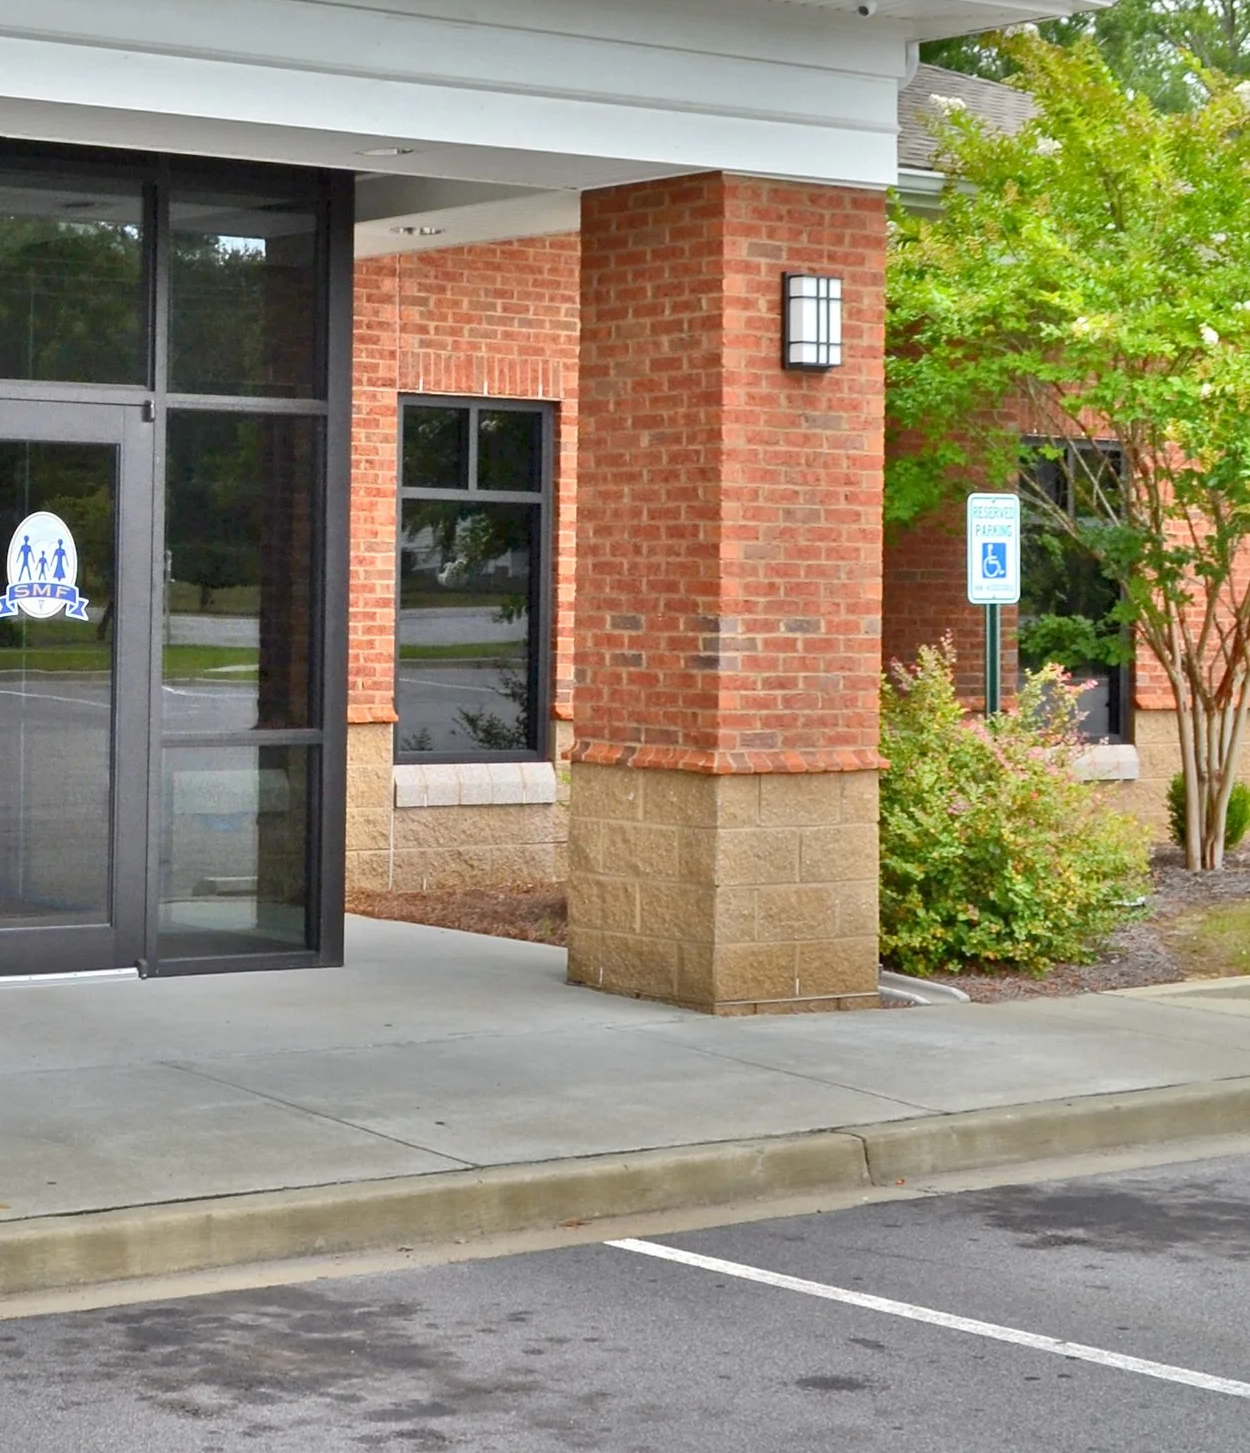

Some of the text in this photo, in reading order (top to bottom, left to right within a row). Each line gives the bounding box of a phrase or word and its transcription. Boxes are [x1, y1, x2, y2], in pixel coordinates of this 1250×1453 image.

[973, 506, 1014, 519] RESERVED
[975, 524, 1012, 537] PARKING
[14, 583, 71, 598] SMF
